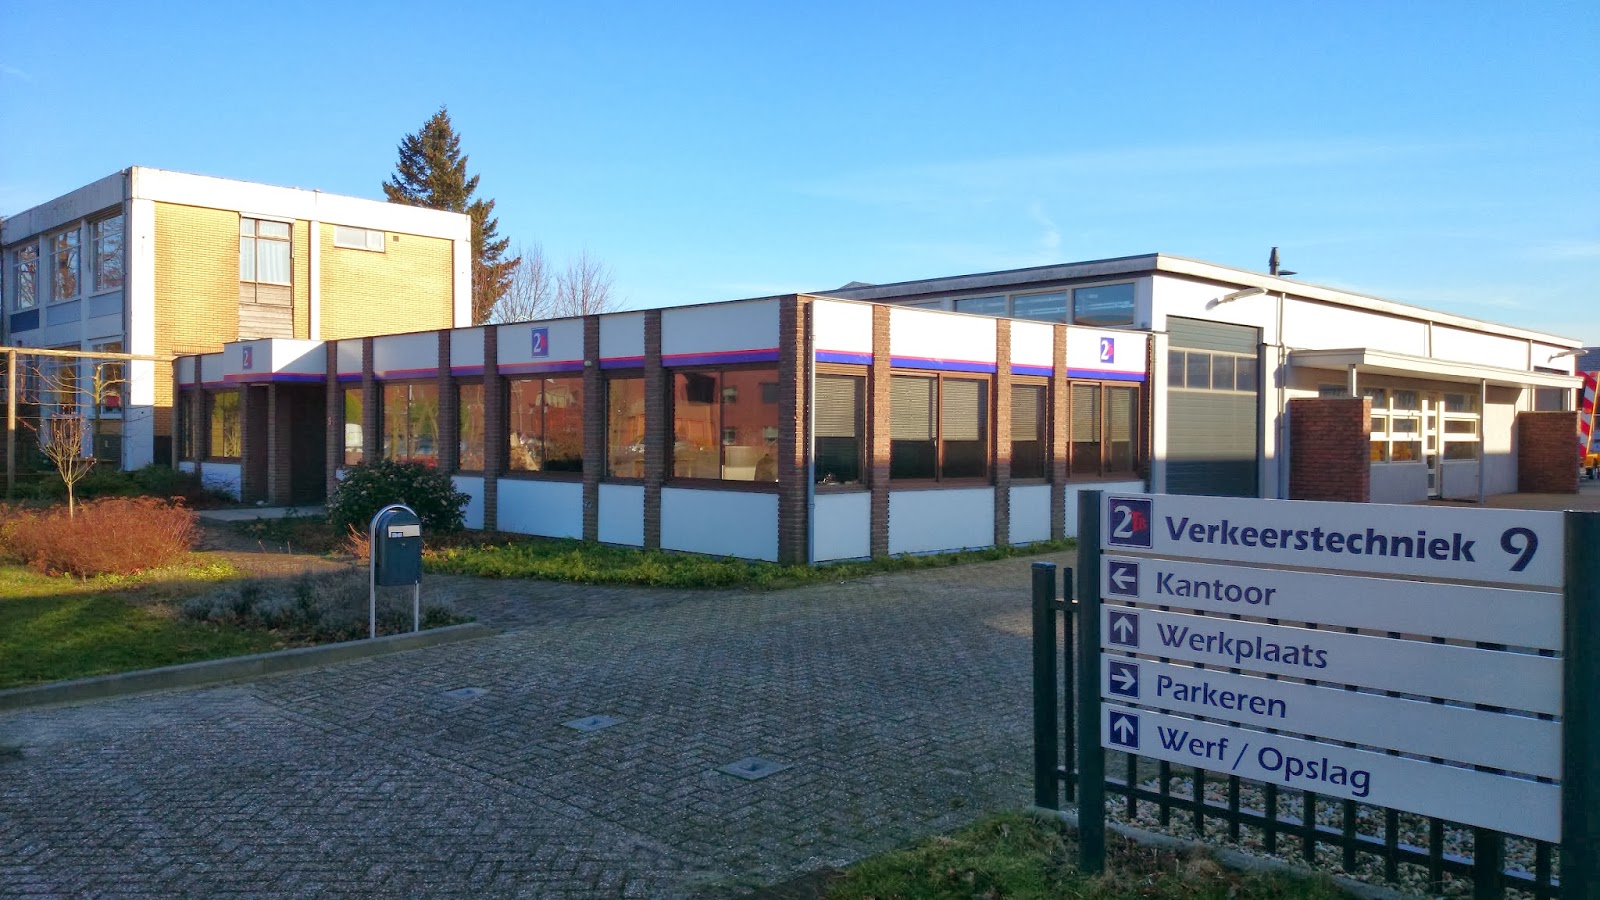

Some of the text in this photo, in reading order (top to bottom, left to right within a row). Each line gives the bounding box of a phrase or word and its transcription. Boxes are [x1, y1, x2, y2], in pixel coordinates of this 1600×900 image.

[1101, 340, 1110, 361] 2
[1165, 516, 1539, 572] Verkeerstechniek 9
[1156, 571, 1276, 605] Kantoor
[1157, 623, 1328, 669] Werkplaats
[1156, 674, 1287, 718] Parkeren
[1157, 726, 1371, 798] Werf / Opslag
